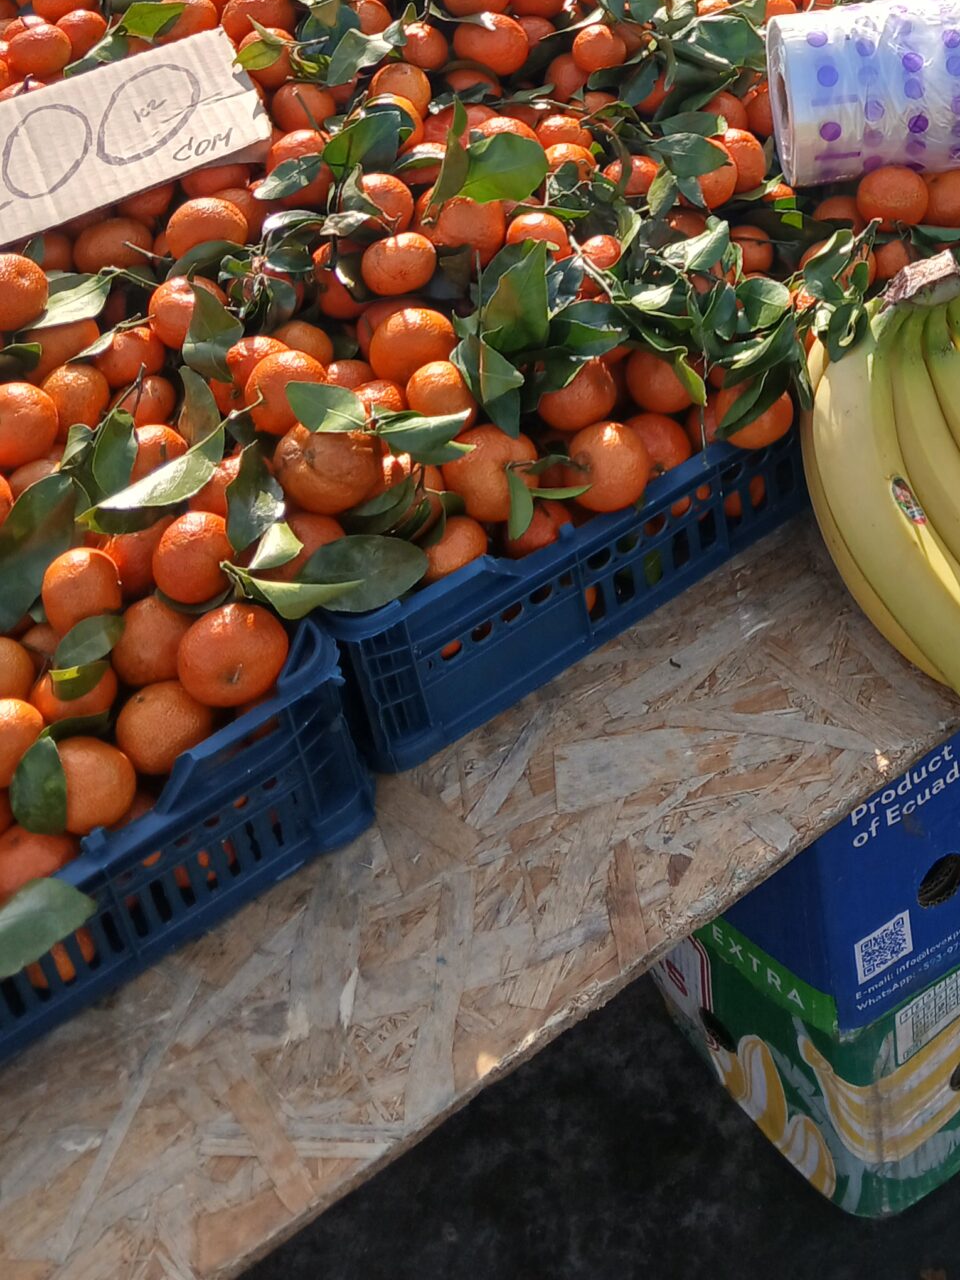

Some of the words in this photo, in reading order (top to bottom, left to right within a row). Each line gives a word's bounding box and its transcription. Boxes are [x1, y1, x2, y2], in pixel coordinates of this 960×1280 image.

[850, 744, 954, 827] Product
[852, 816, 881, 848] of
[712, 923, 805, 1010] EXTRA
[855, 973, 894, 1000] E-mail:
[856, 970, 916, 1012] WhatsApp:
